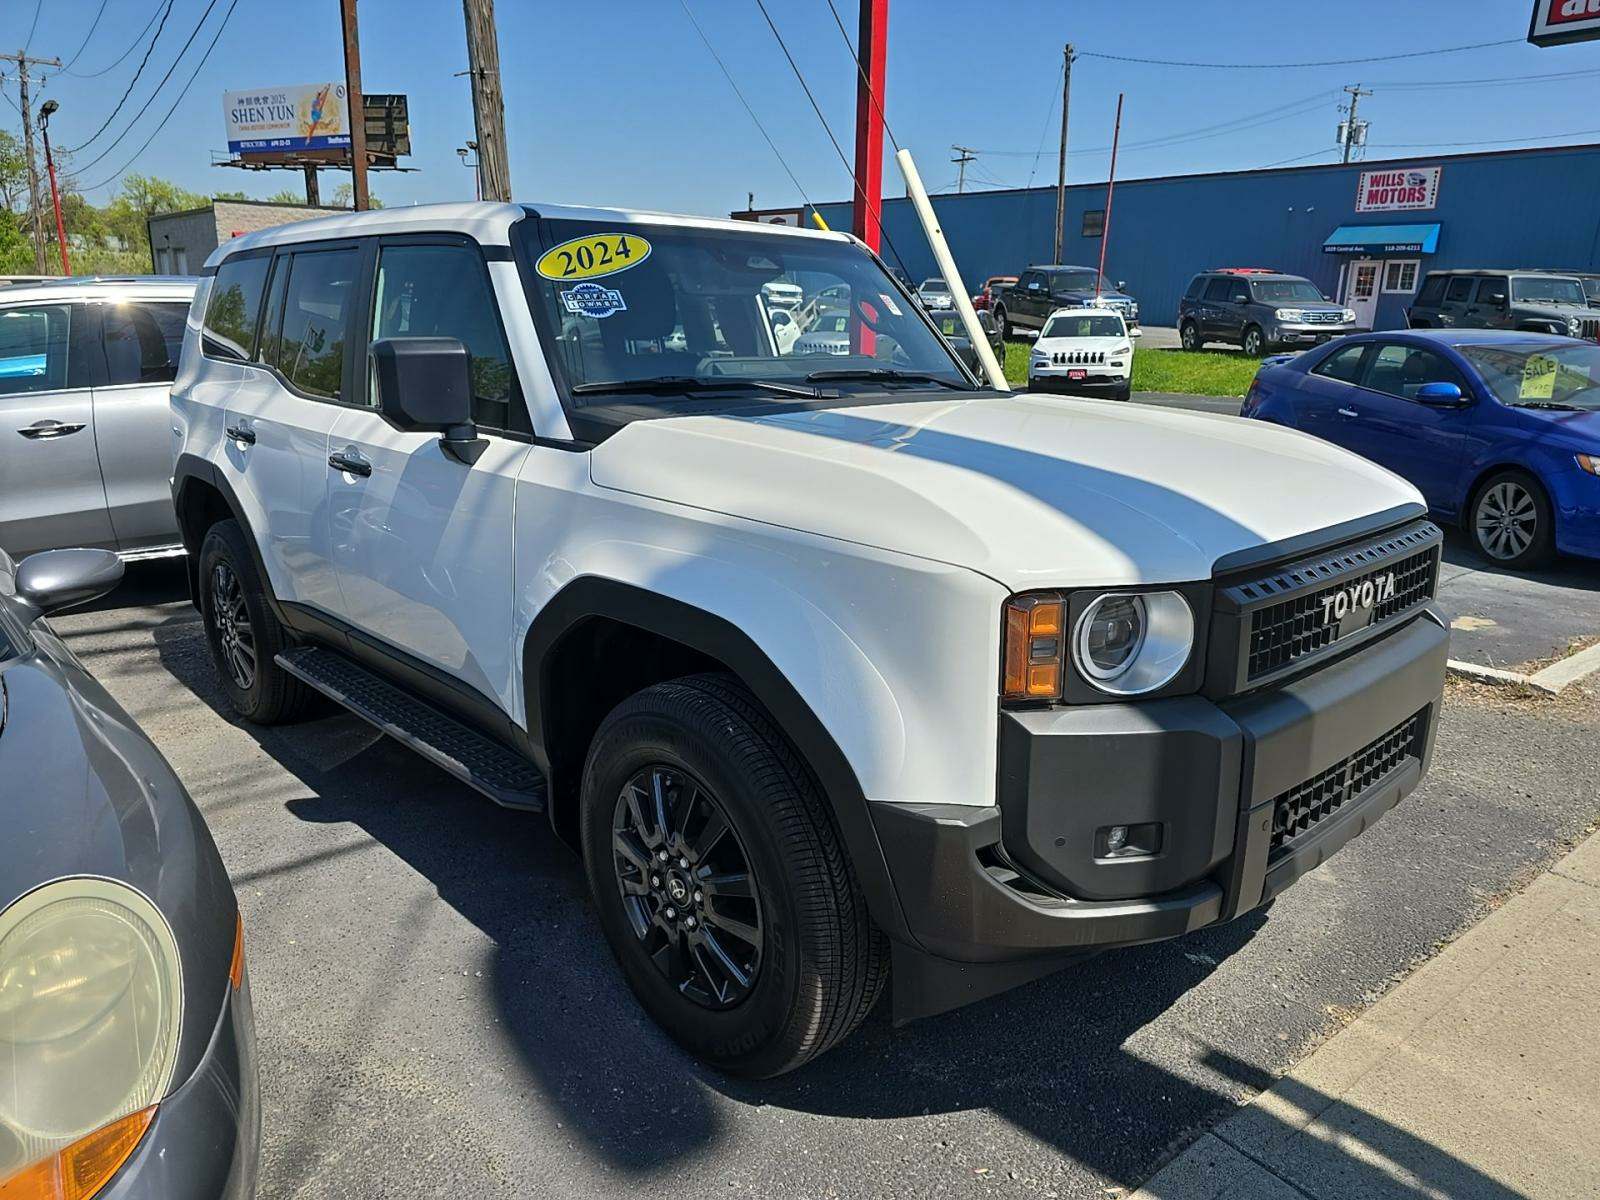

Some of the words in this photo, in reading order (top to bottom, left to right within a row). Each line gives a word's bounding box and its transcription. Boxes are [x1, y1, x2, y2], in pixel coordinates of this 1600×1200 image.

[271, 94, 286, 105] 2025
[232, 108, 264, 124] SHEN
[270, 105, 295, 121] YUN
[1370, 173, 1405, 187] WILLS
[1367, 187, 1426, 205] MOTORS
[557, 236, 631, 276] 2024
[567, 291, 618, 301] CARFAX
[578, 300, 620, 308] OWNER
[1525, 360, 1555, 380] SALE
[1322, 572, 1395, 624] TOYOTA
